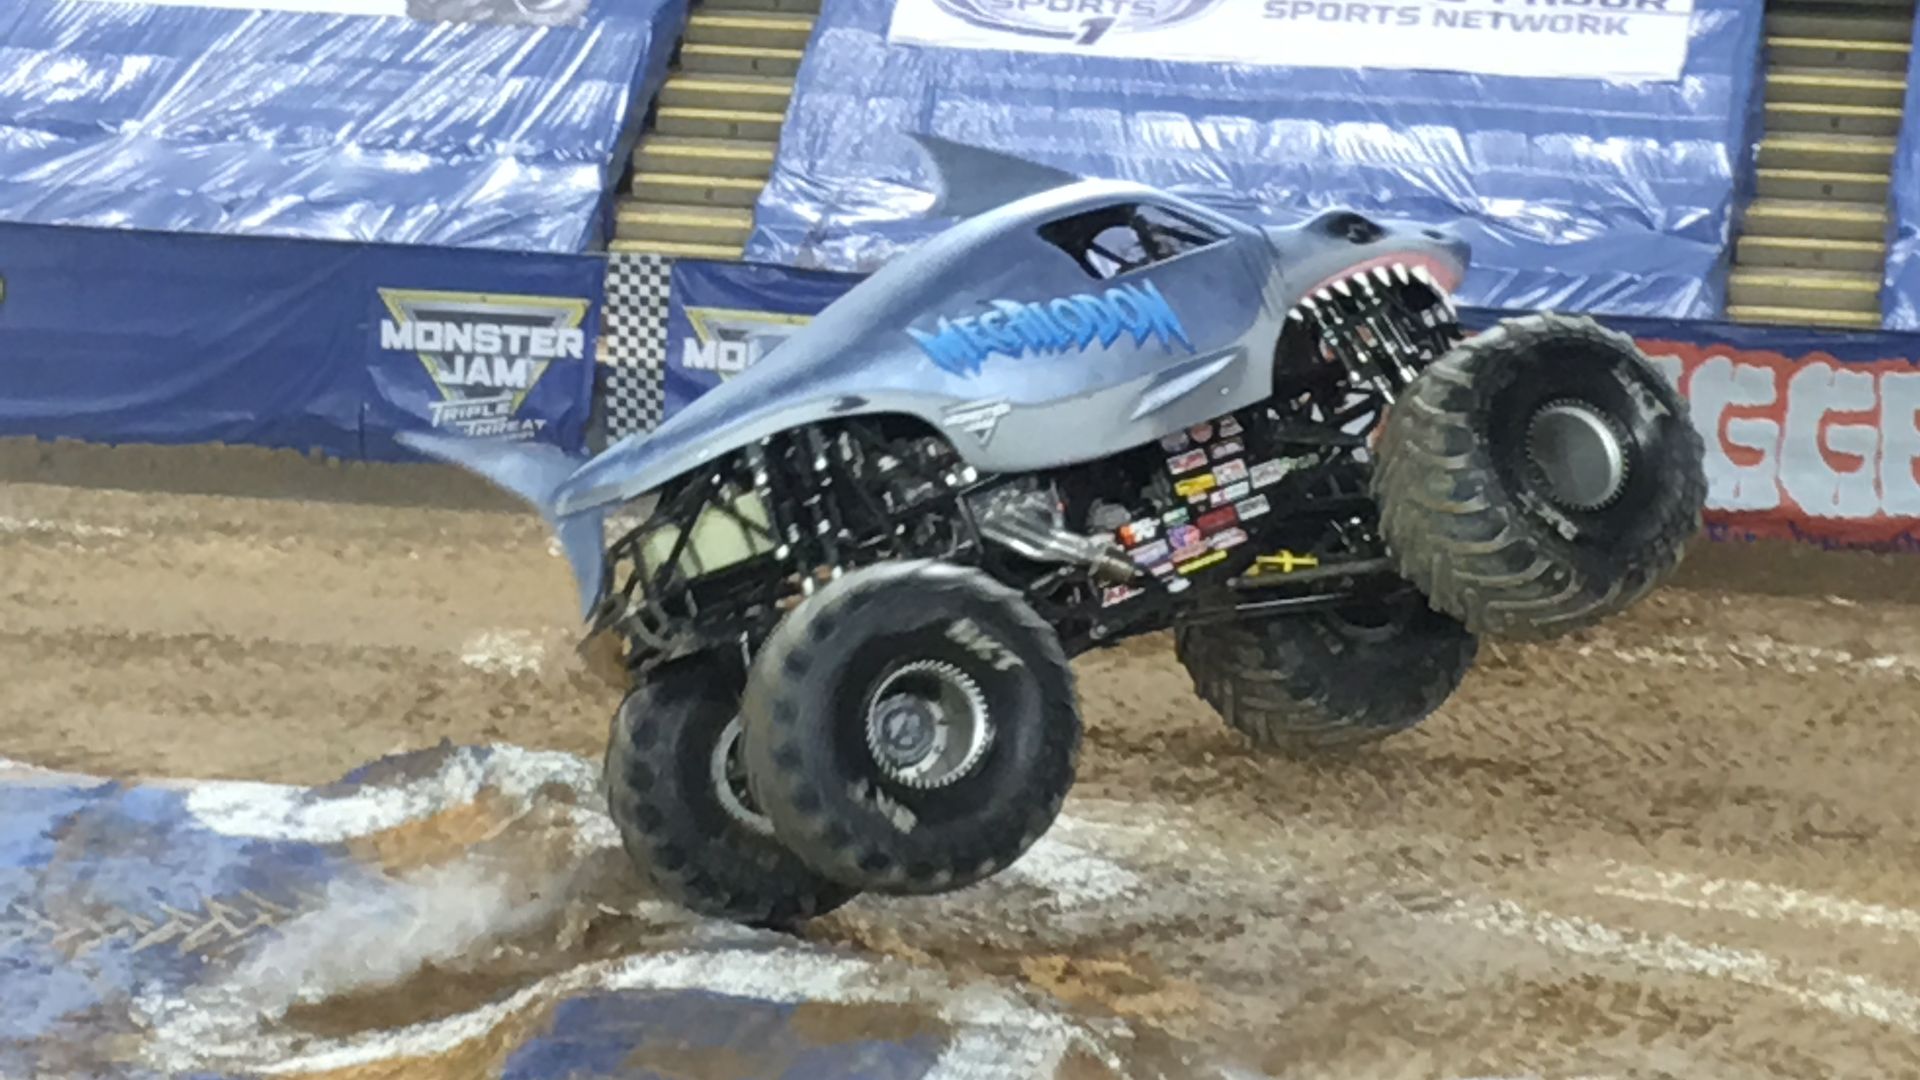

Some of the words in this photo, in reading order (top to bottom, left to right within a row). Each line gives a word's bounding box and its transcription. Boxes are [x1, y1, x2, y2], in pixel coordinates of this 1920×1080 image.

[1262, 0, 1422, 26] SPORTS
[1432, 8, 1630, 36] NETWORK
[380, 318, 585, 360] MONSTER
[905, 278, 1196, 378] MEGALODON
[437, 354, 530, 388] JAM
[428, 394, 514, 428] TRIPLE
